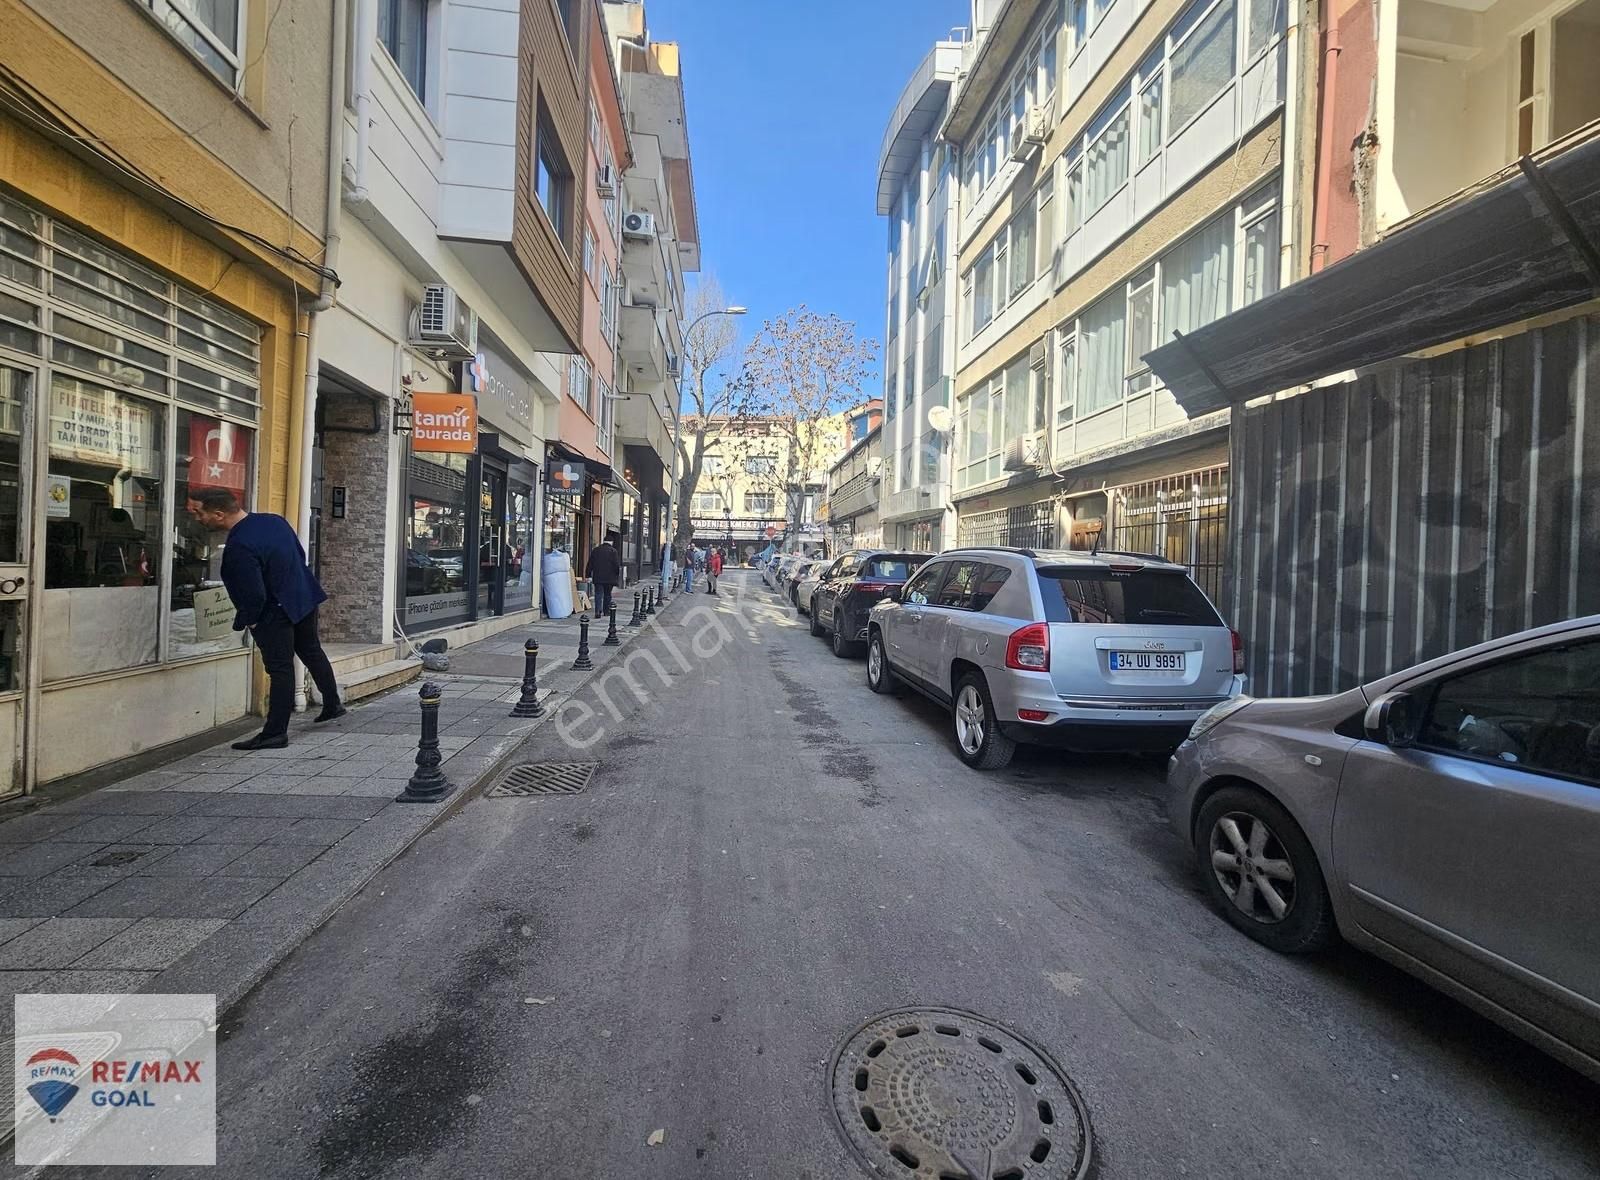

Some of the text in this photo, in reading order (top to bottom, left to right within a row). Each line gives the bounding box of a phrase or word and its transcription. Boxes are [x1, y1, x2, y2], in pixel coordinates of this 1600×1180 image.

[414, 408, 470, 428] tamir
[414, 426, 472, 441] burada
[408, 601, 429, 615] iPhone
[1118, 654, 1182, 669] 34 UU 9891
